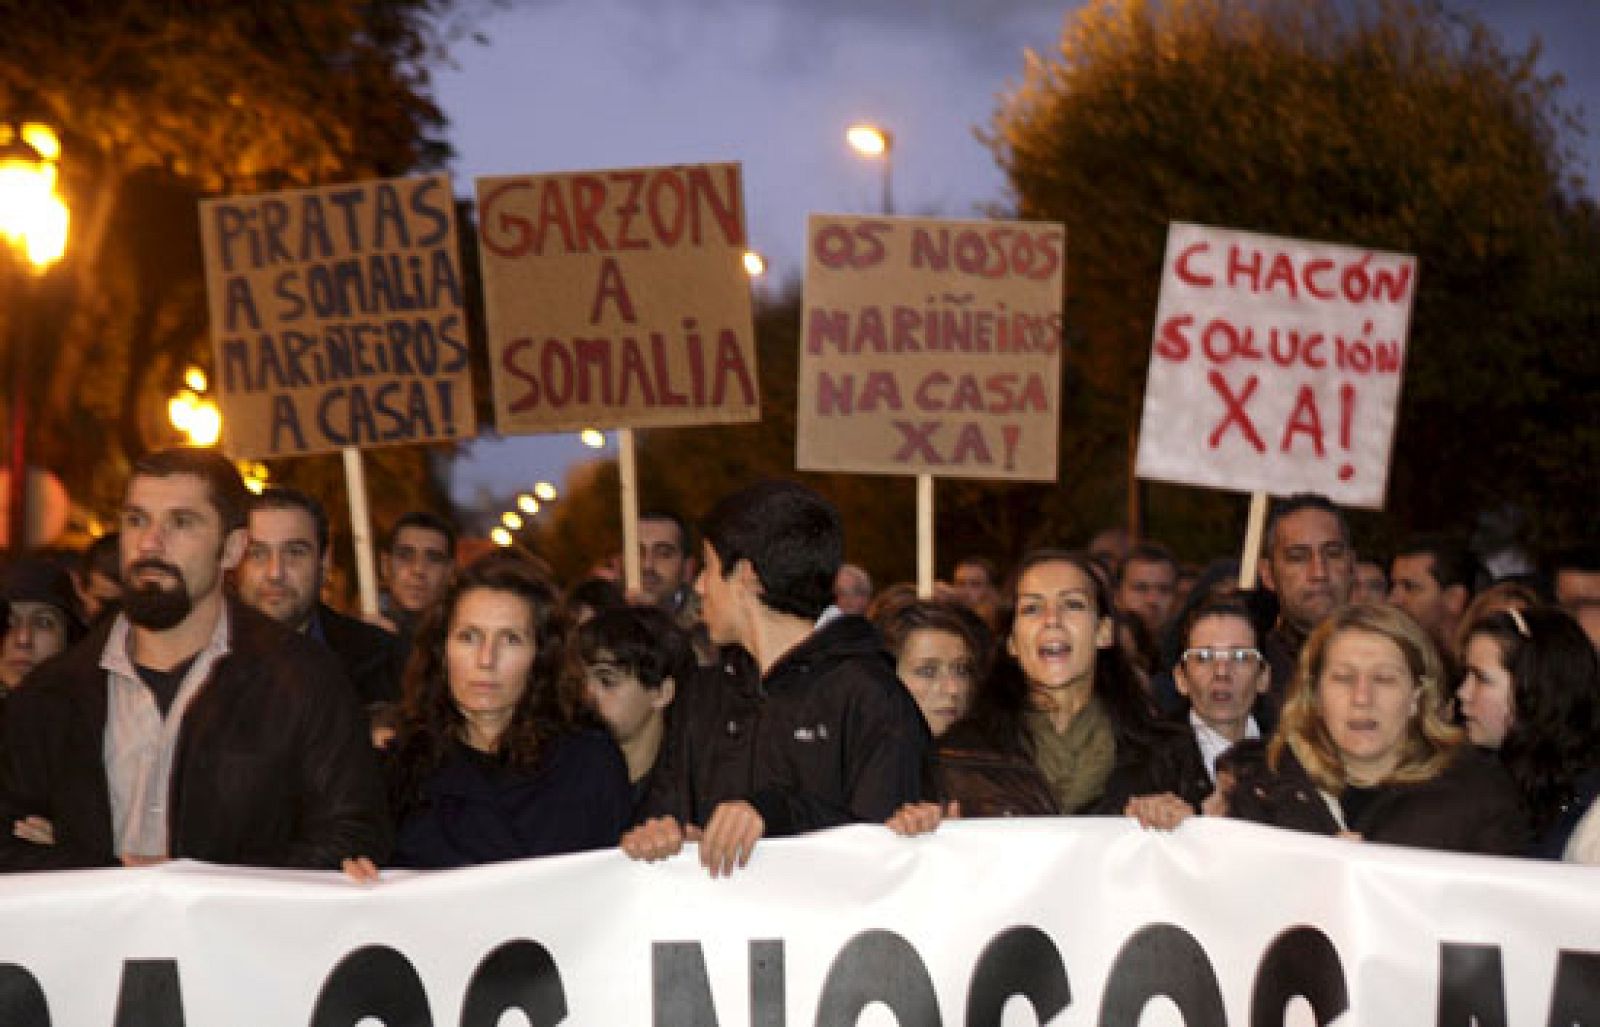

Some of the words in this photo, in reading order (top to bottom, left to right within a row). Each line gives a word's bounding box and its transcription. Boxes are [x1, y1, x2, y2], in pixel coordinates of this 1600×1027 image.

[814, 221, 893, 270] OS
[909, 227, 1062, 281] NOSOS
[1173, 241, 1412, 304] CHACÓN
[226, 276, 262, 330] A
[591, 257, 637, 324] A
[1155, 314, 1401, 375] SOLUCIÓN
[270, 393, 307, 449] A
[317, 380, 455, 445] CASA!
[817, 371, 903, 416] NA
[913, 371, 1048, 415] CASA
[892, 421, 1021, 472] XA!
[1206, 369, 1357, 482] XA!
